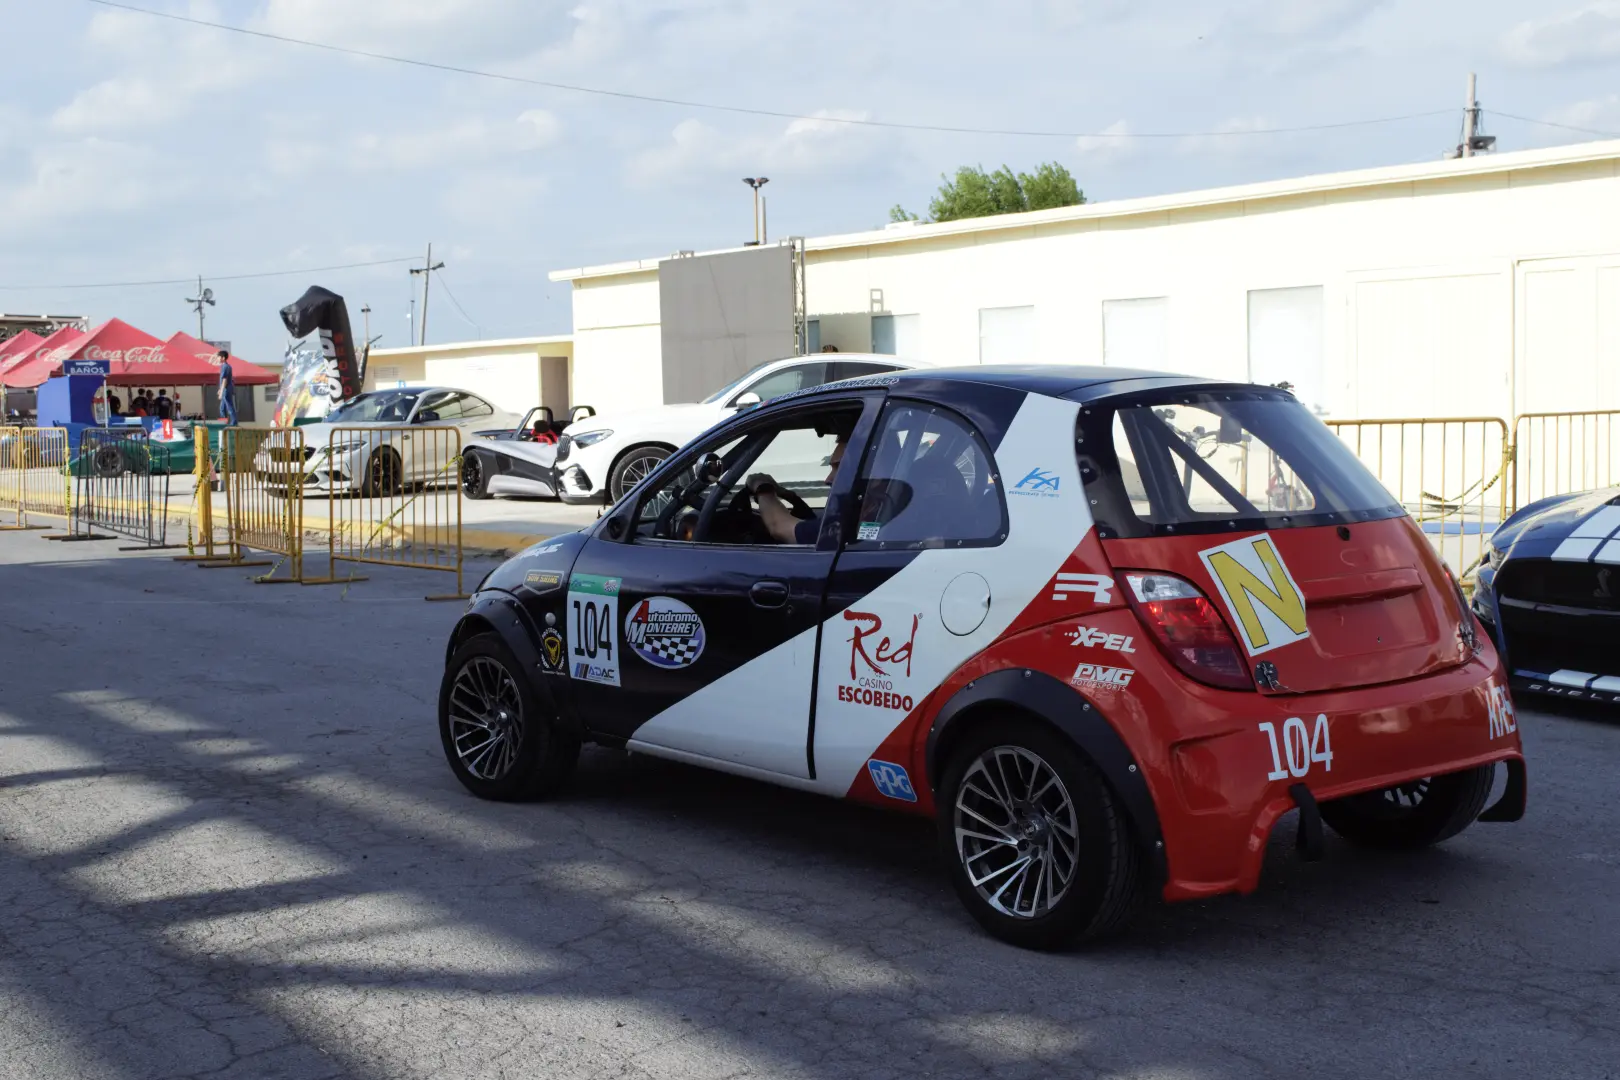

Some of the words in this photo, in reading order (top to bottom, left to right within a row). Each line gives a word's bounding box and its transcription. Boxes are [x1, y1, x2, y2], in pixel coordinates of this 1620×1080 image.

[70, 365, 105, 375] BAÑOS
[1206, 538, 1307, 650] N
[631, 600, 698, 624] Autodromo
[573, 600, 613, 661] 104
[627, 622, 700, 644] MONTERREY
[1069, 626, 1136, 653] XPEL
[843, 609, 919, 681] Red
[588, 666, 615, 679] ADAC
[858, 677, 893, 691] CASINO
[1073, 663, 1135, 687] PMG
[1067, 679, 1127, 692] MOTORSPORTS
[838, 685, 914, 712] ESCOBEDO
[1258, 713, 1334, 782] 104
[871, 765, 913, 796] PPG
